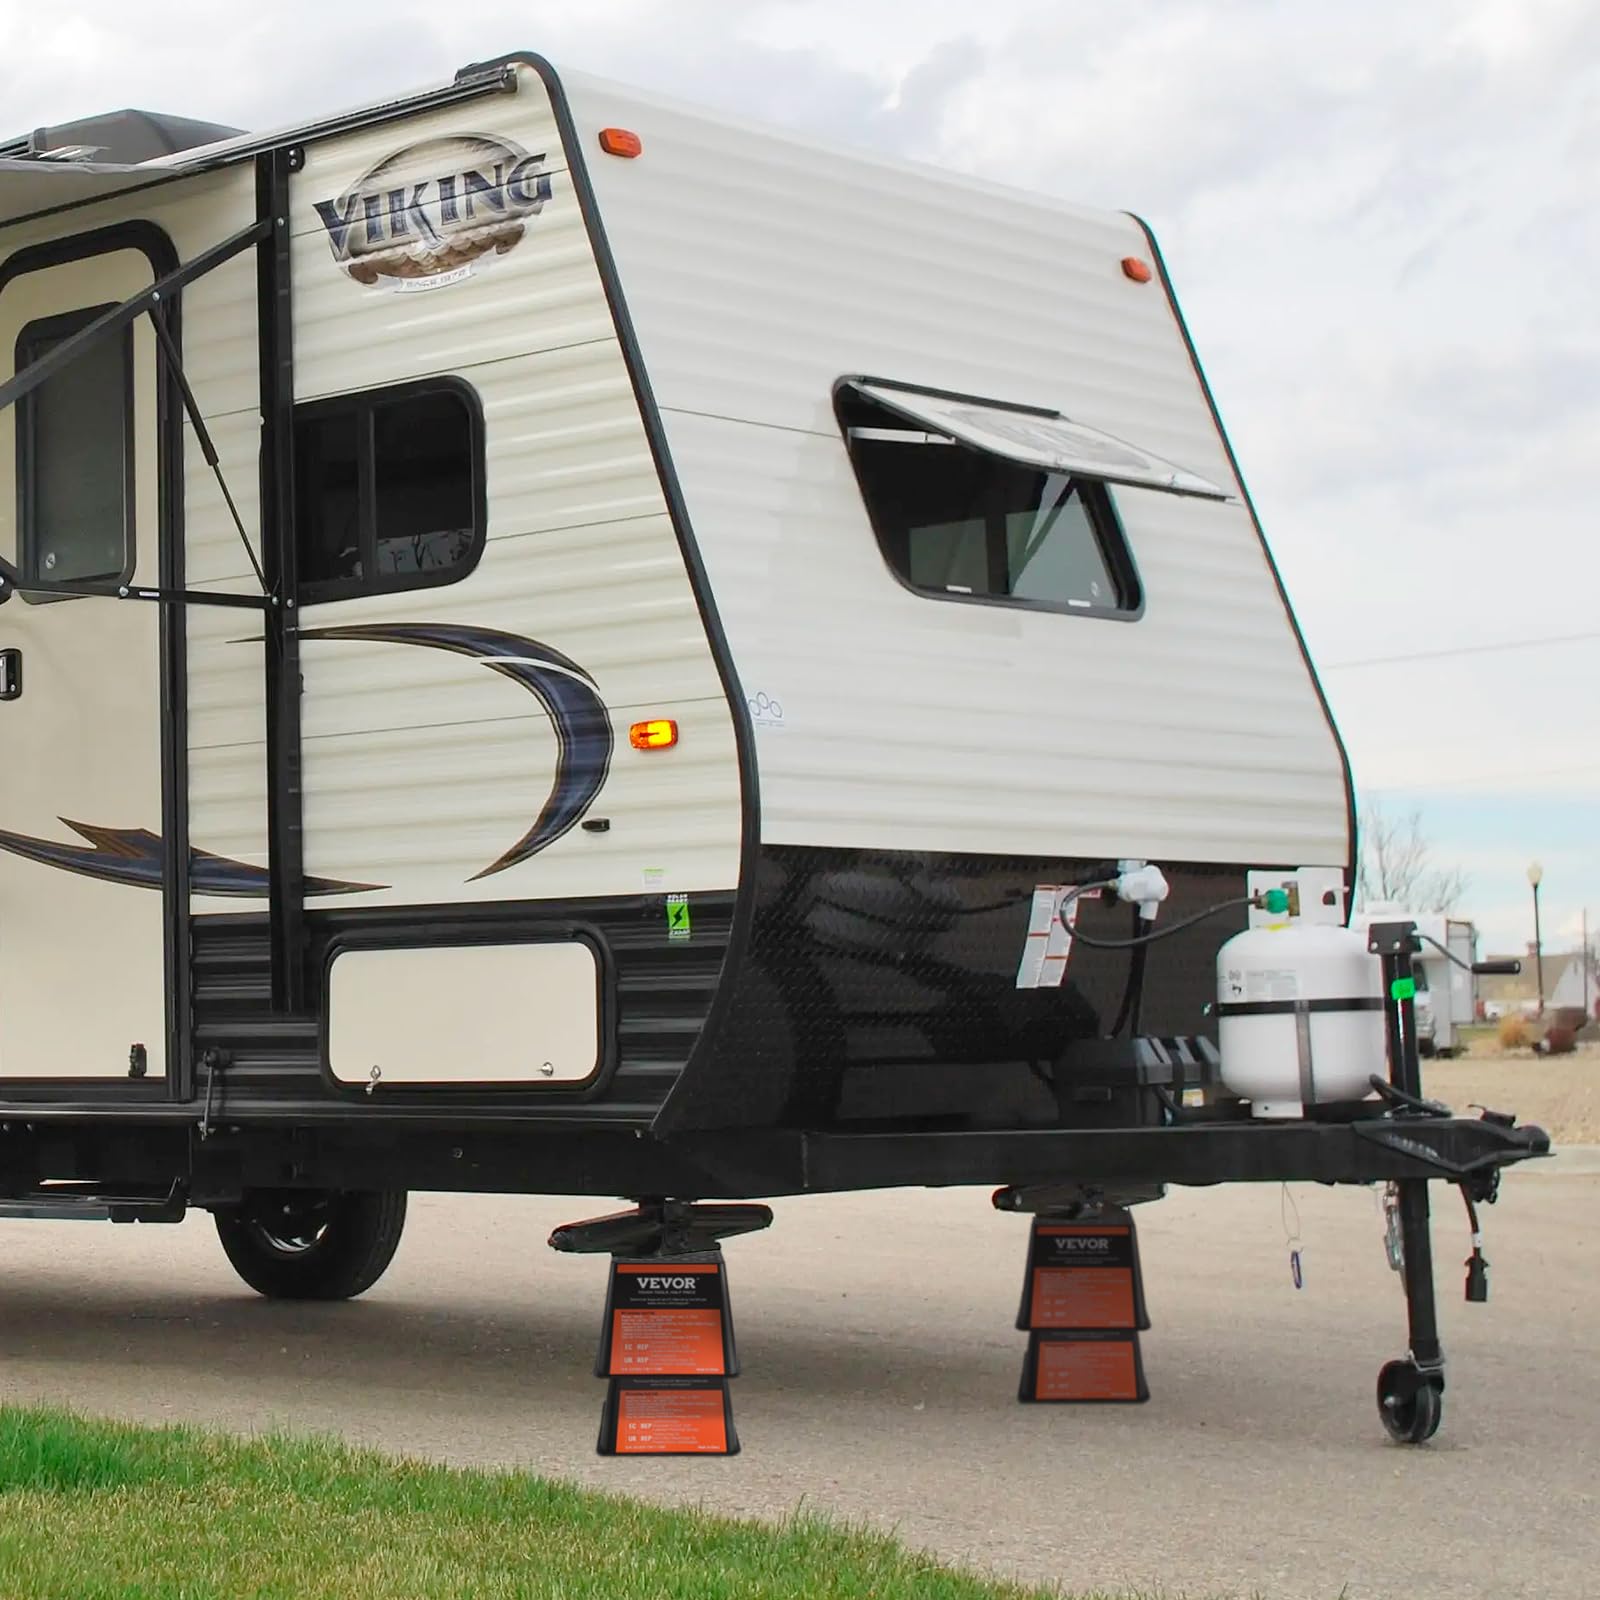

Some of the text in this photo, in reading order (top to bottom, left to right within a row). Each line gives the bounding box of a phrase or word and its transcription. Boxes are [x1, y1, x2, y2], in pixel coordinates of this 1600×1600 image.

[312, 152, 553, 262] VIKING
[1055, 1237, 1109, 1249] VEVOR
[636, 1277, 696, 1289] VEVOR
